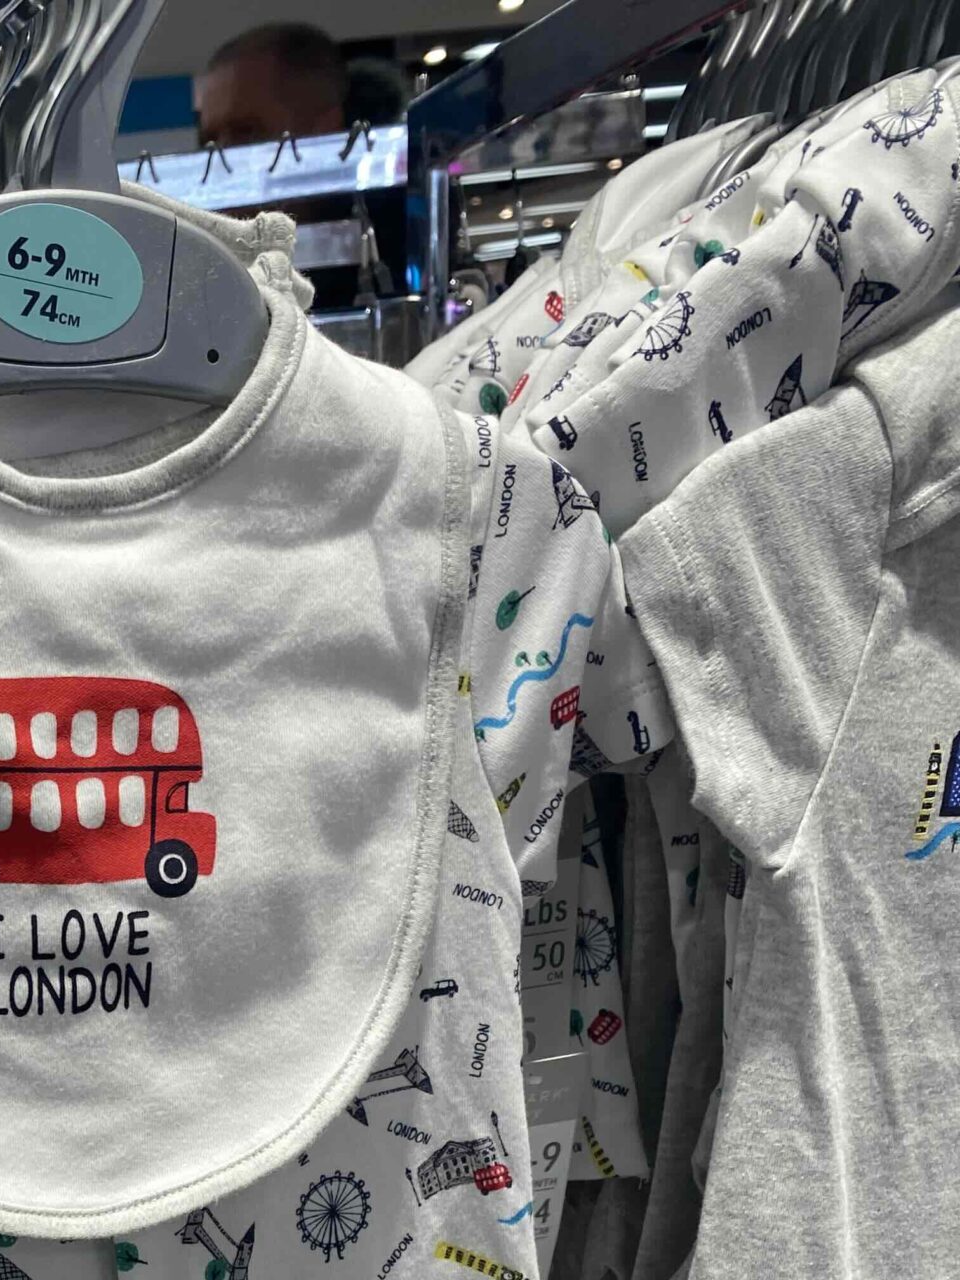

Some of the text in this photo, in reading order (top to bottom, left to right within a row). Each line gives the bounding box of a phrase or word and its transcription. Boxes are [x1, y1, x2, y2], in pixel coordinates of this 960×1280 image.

[705, 171, 751, 211] LONDON
[893, 191, 935, 243] LONDON
[7, 236, 100, 287] 6-9 MTH
[20, 288, 81, 328] 74 CM
[726, 307, 772, 349] LONDON
[475, 416, 490, 468] LONDO
[628, 422, 648, 482] LONDON
[495, 464, 517, 538] LONDON
[524, 788, 564, 844] LONDON
[452, 883, 504, 909] LONDON
[30, 909, 151, 960] LOVE
[532, 941, 565, 971] 50
[468, 1023, 491, 1078] LONDON
[387, 1120, 432, 1145] LONDON
[377, 1233, 414, 1280] LONDON
